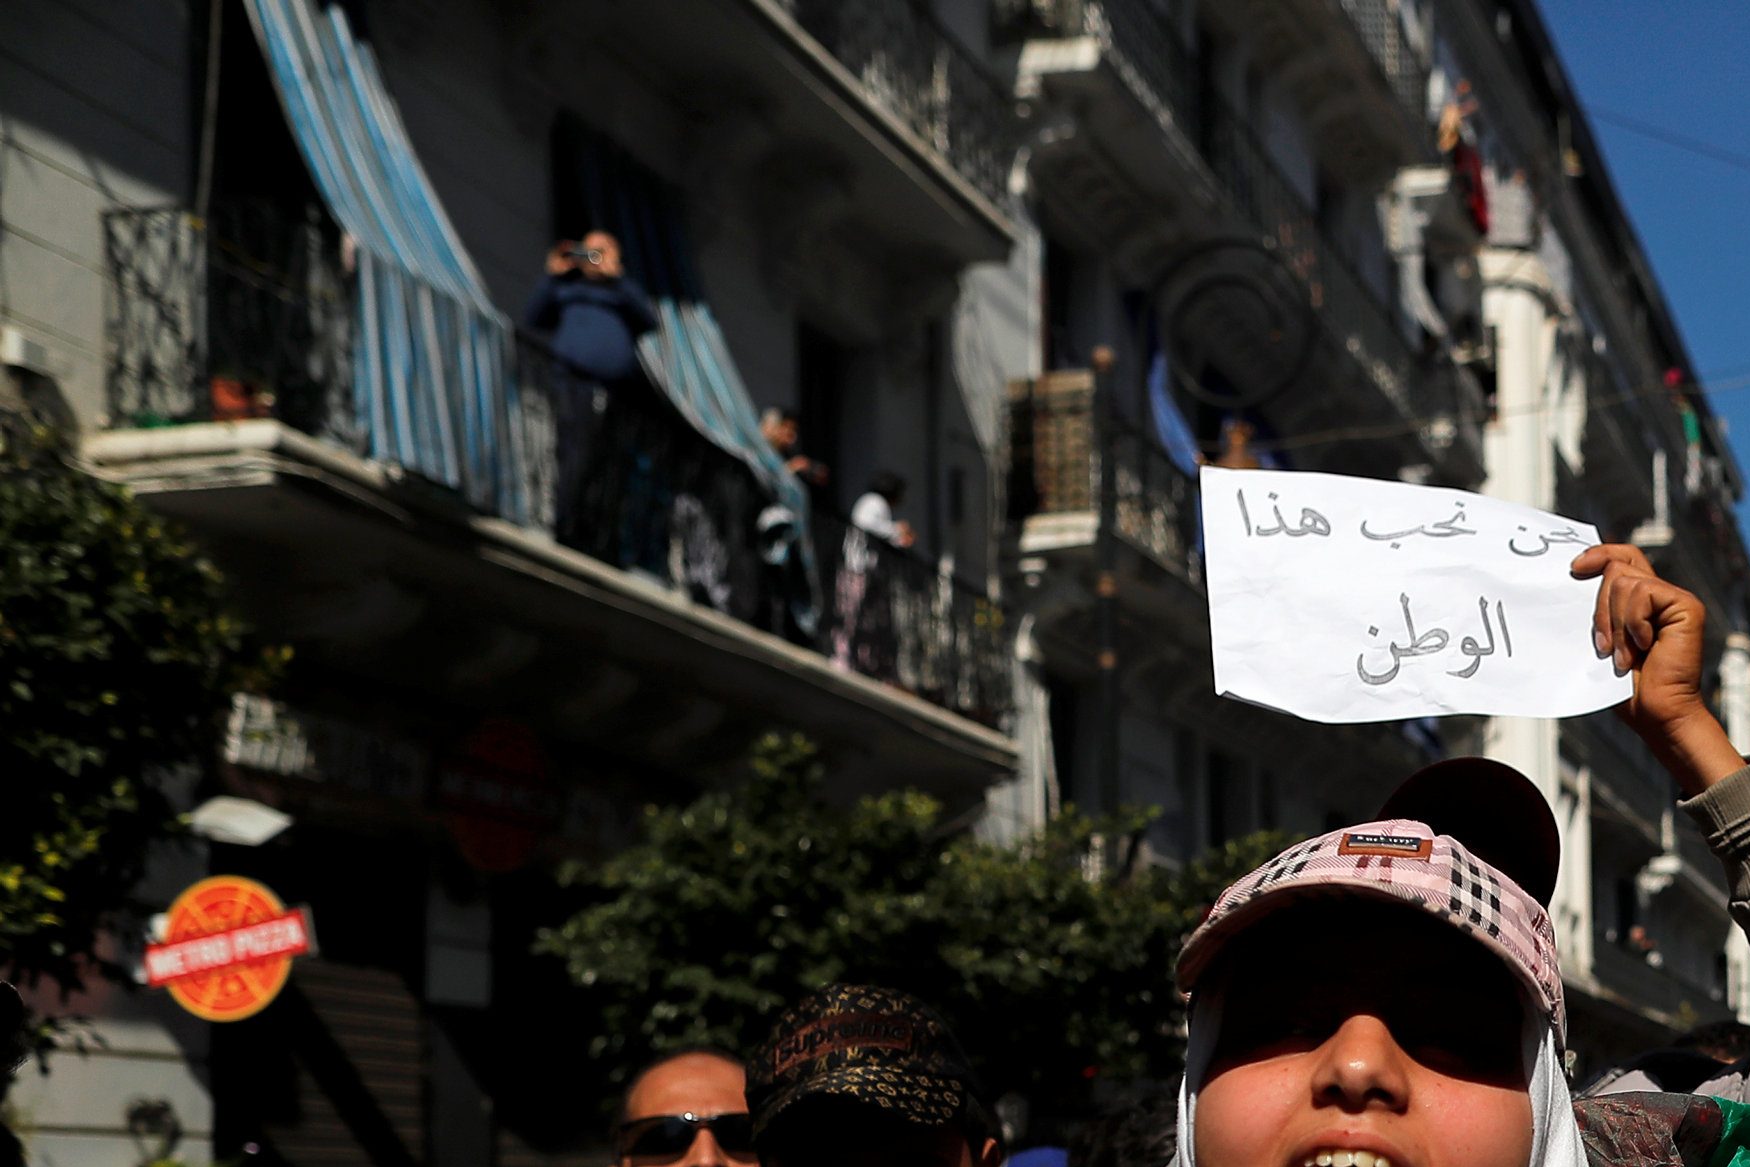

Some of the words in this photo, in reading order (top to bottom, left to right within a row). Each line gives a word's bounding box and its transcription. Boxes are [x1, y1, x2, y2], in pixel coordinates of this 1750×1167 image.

[1236, 488, 1332, 538] هذا
[1360, 500, 1477, 550] نحب
[1356, 592, 1513, 685] الوطن
[231, 916, 304, 961] PIZZA
